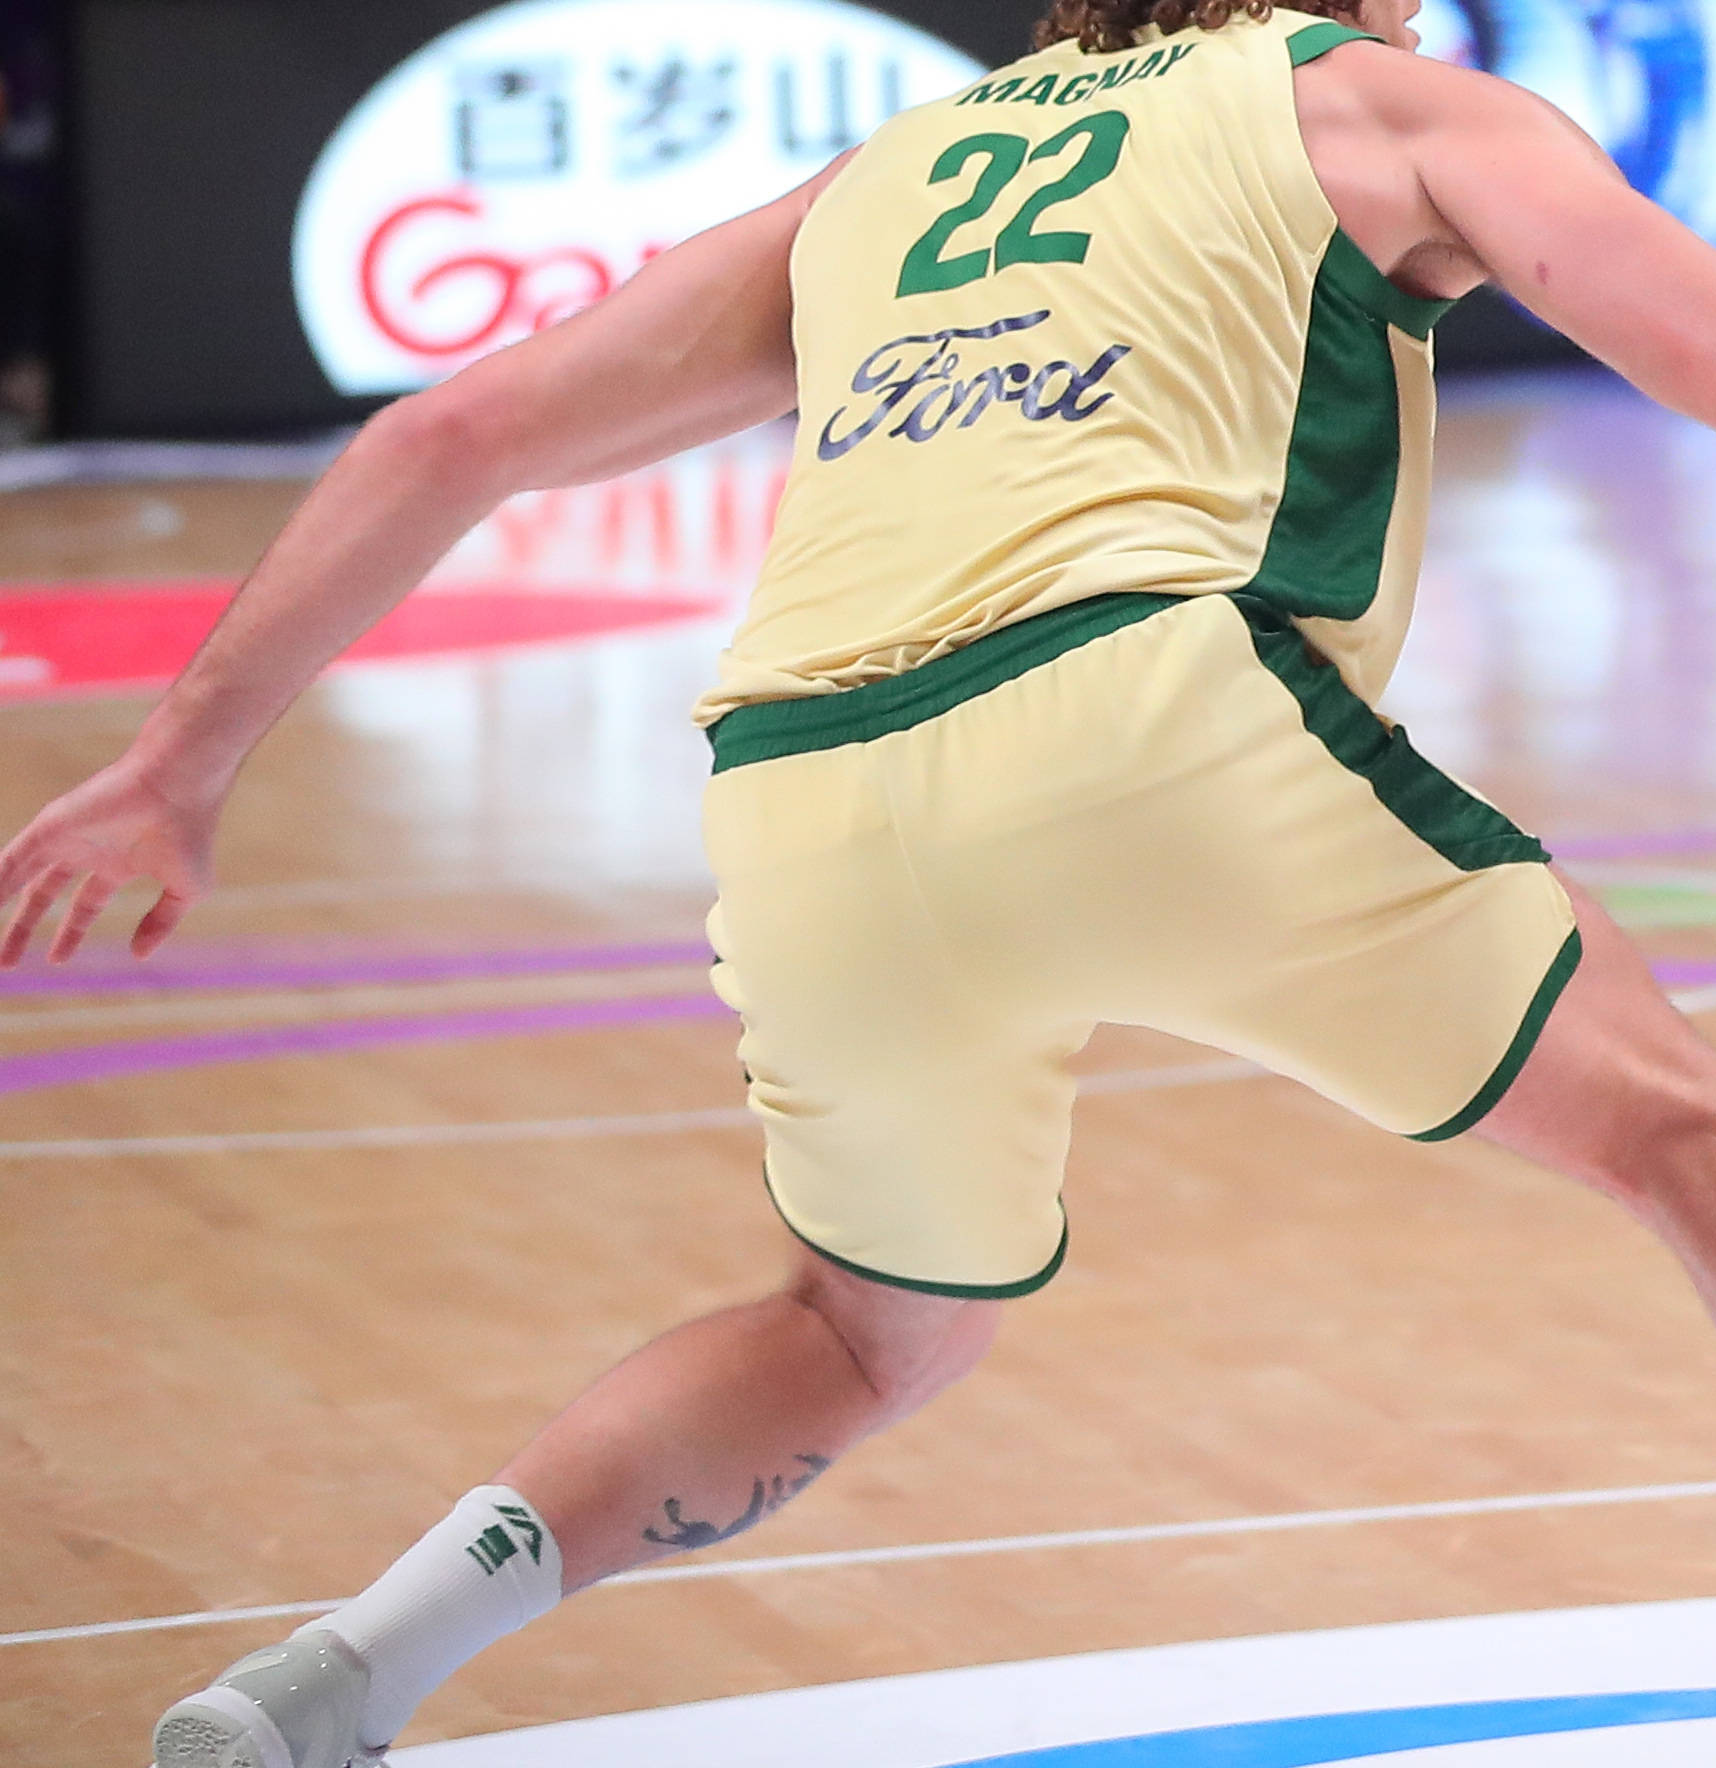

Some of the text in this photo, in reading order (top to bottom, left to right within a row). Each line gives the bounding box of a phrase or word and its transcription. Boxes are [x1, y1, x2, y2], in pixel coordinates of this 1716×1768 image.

[954, 41, 1199, 107] MAGNAY
[894, 109, 1131, 300] 22
[816, 308, 1133, 462] Ford
